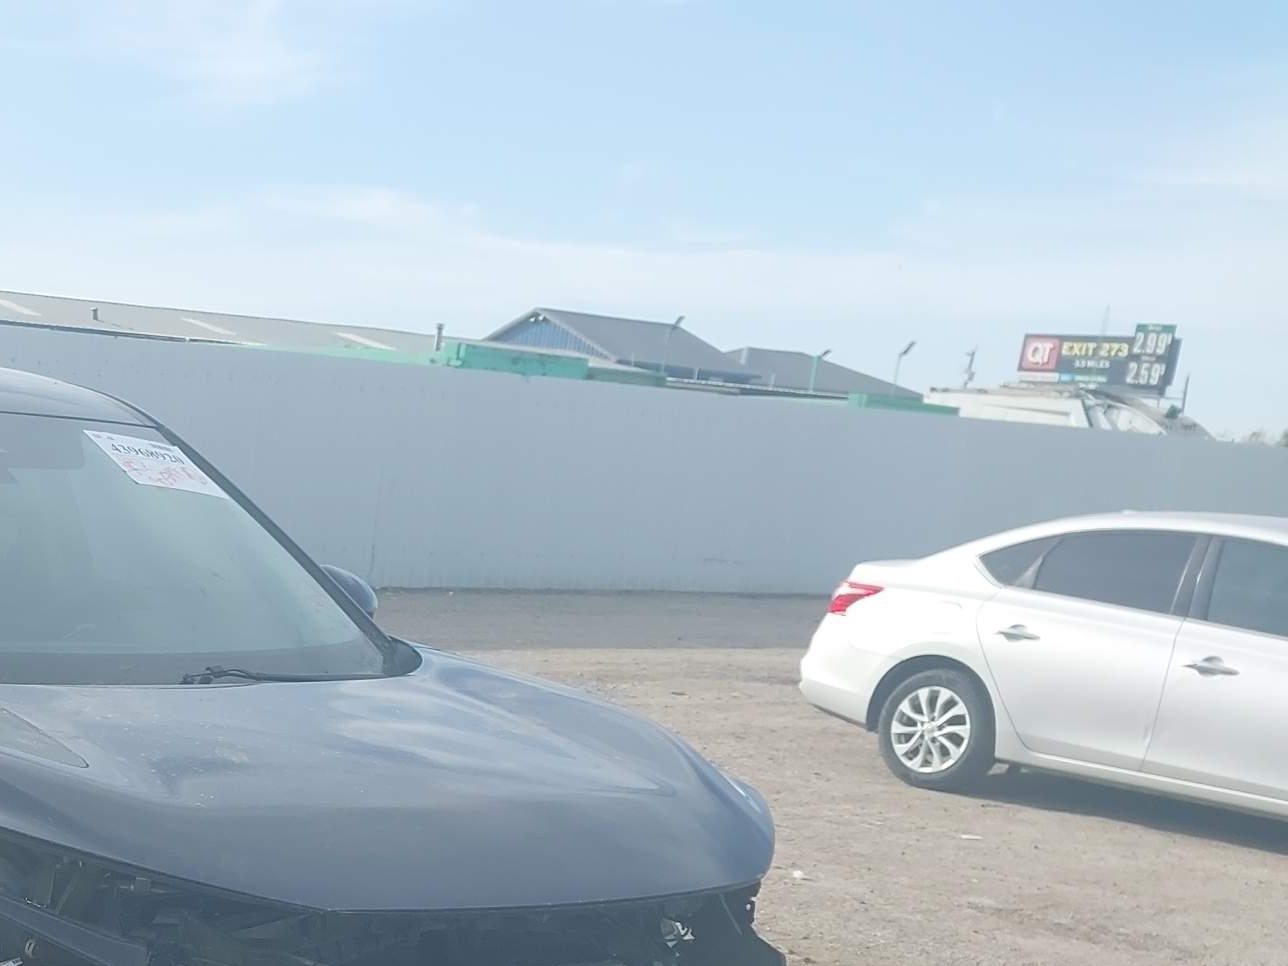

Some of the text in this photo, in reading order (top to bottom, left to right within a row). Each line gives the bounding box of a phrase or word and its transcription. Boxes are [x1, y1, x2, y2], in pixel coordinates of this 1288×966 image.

[1027, 341, 1054, 366] QT
[1062, 341, 1129, 358] EXIT 273
